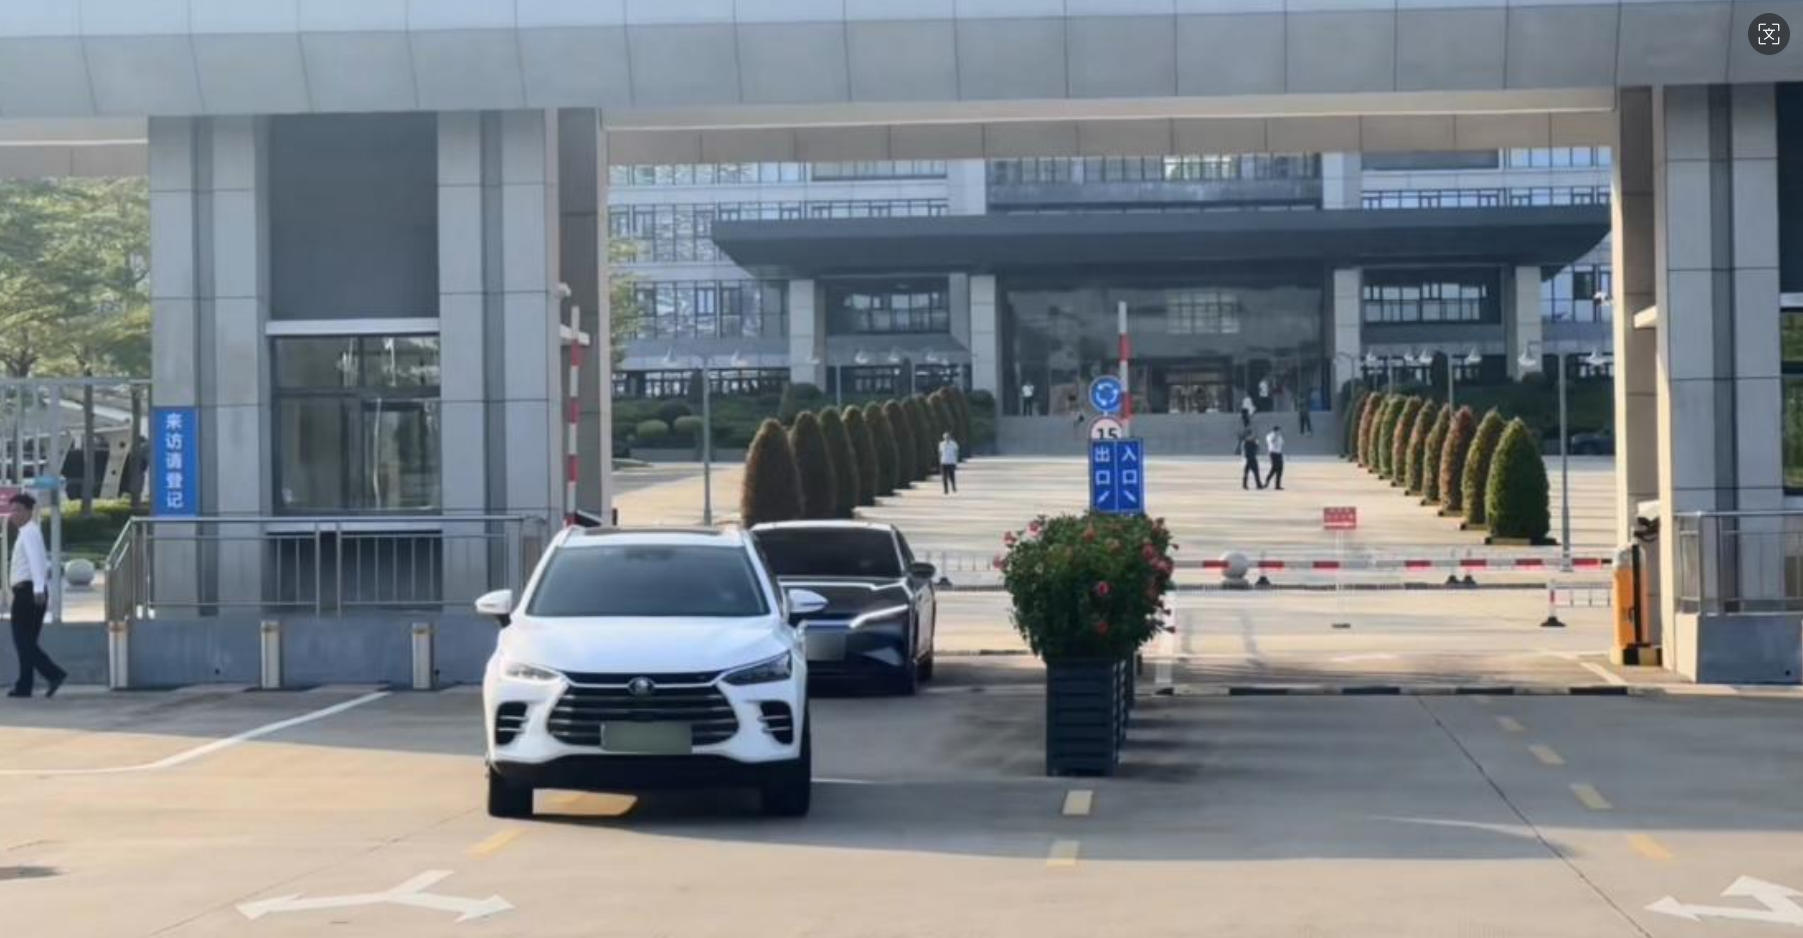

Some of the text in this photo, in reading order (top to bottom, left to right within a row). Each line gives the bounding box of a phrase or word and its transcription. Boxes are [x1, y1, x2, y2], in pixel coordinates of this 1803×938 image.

[1097, 427, 1118, 439] 15
[165, 412, 184, 509] 来访请登记
[1094, 446, 1111, 486] 出口
[1121, 446, 1138, 486] 入口
